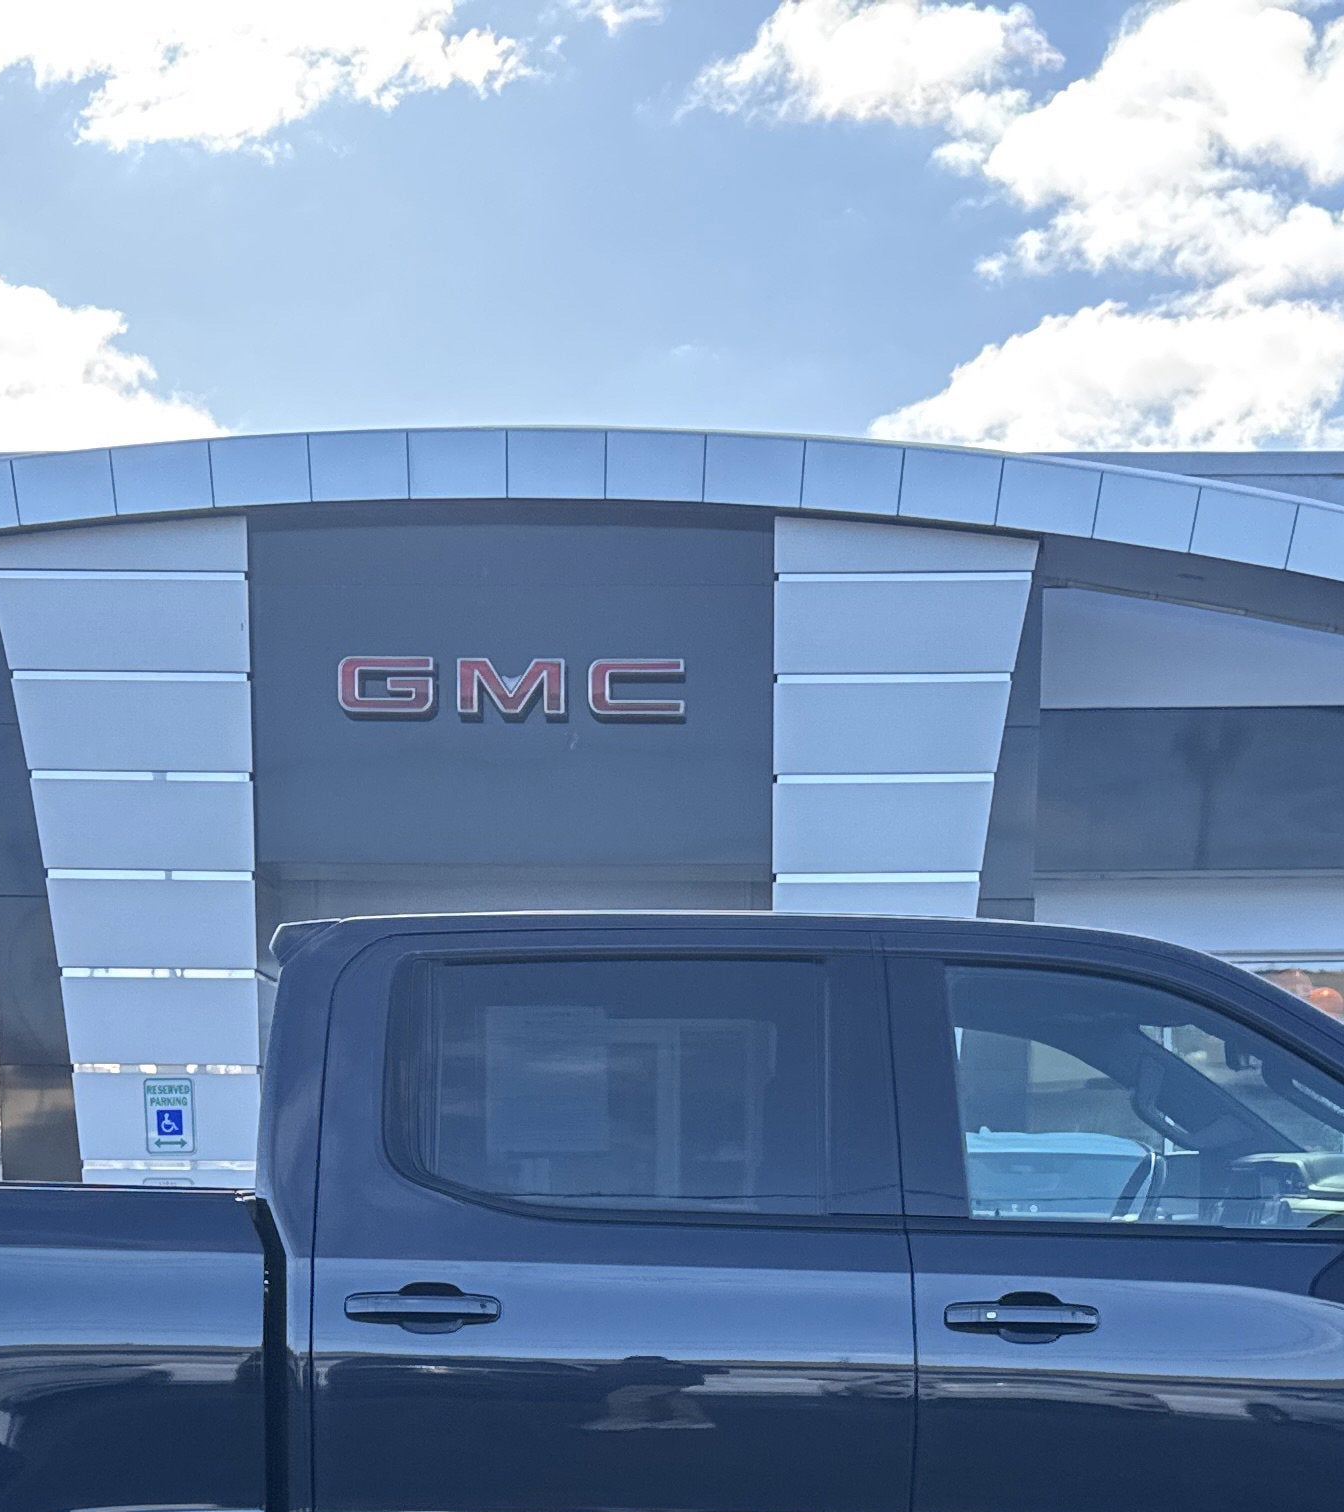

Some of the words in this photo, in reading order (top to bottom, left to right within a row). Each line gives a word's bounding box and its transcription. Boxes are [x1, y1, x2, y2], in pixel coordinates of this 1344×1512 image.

[337, 656, 686, 719] GMC
[146, 1084, 190, 1095] RESERVED
[149, 1096, 188, 1107] PARKING
